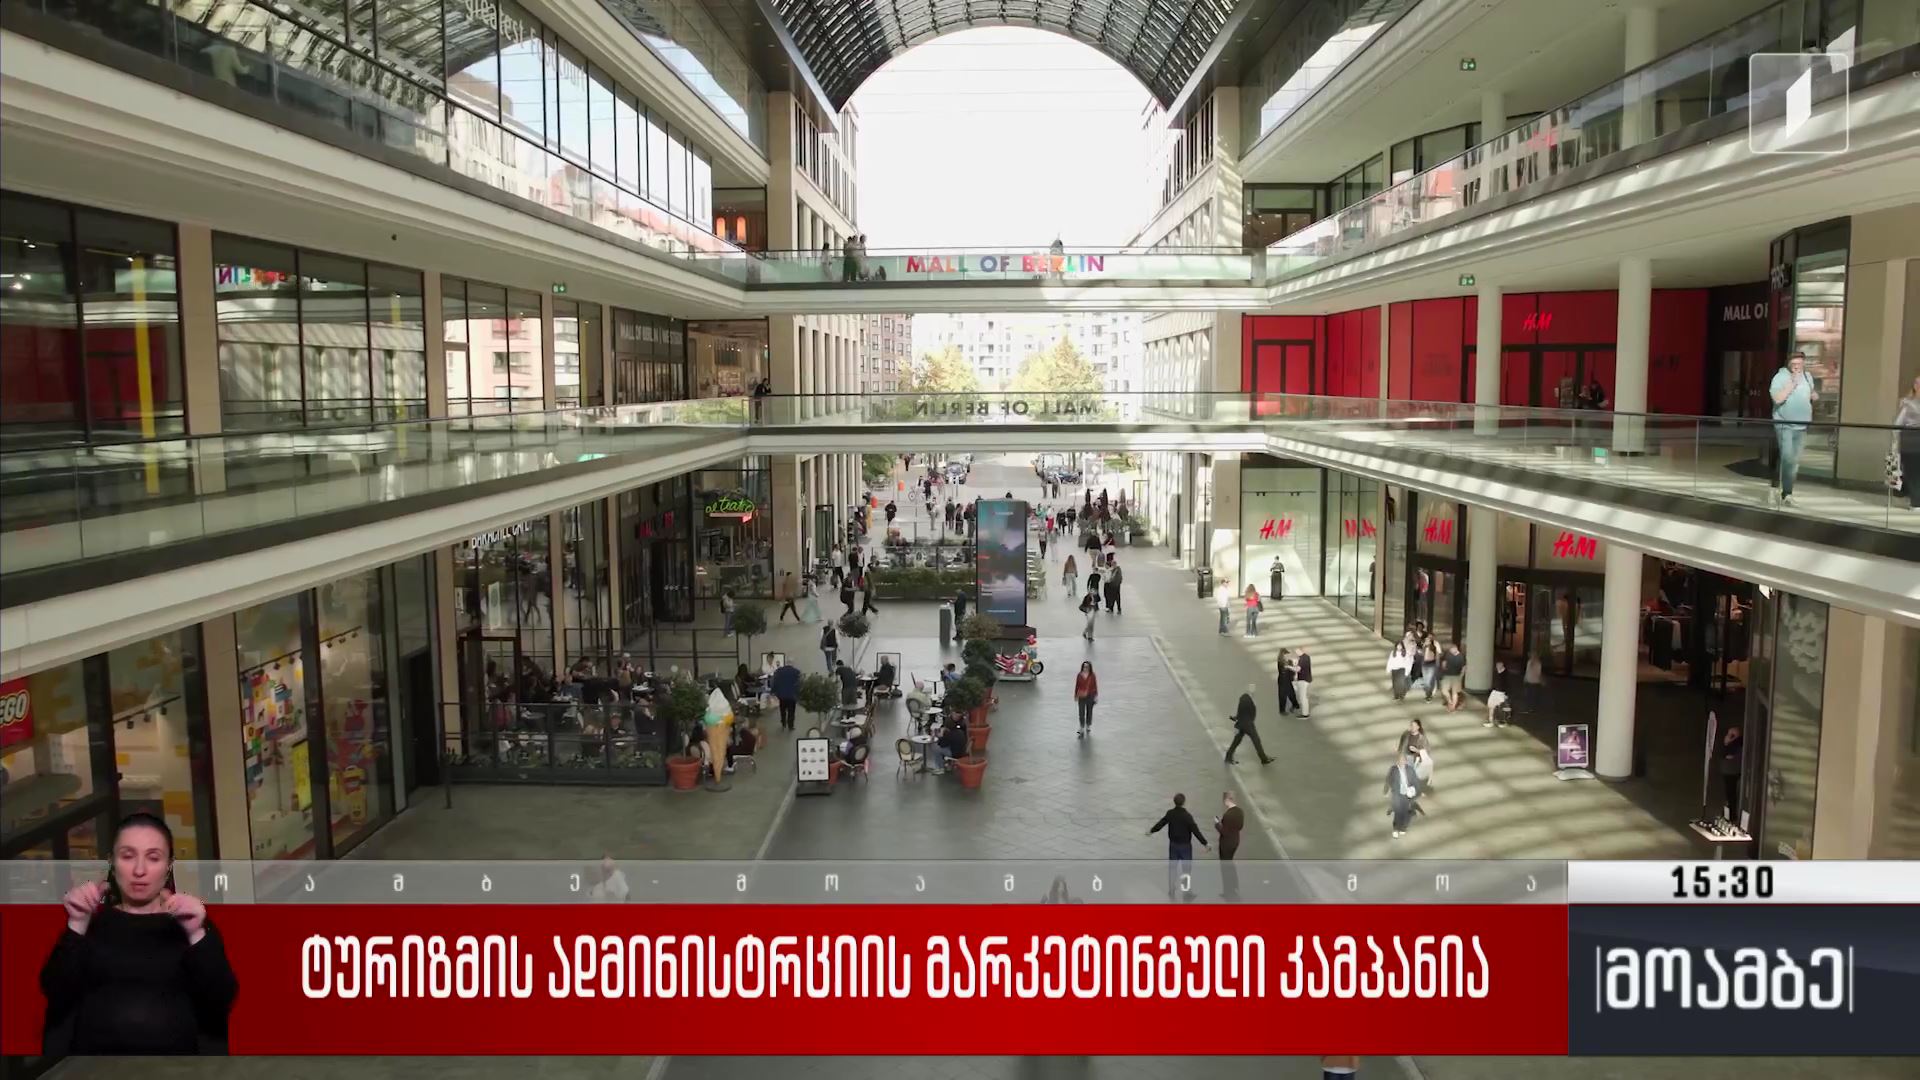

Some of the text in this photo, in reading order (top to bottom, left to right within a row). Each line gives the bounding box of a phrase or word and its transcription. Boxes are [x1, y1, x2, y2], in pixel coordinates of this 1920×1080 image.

[906, 255, 1105, 273] MALL OF BERLIN
[1723, 303, 1752, 322] MALL
[1259, 518, 1293, 541] H&M
[1423, 517, 1453, 545] H&M
[1553, 531, 1598, 561] H&M
